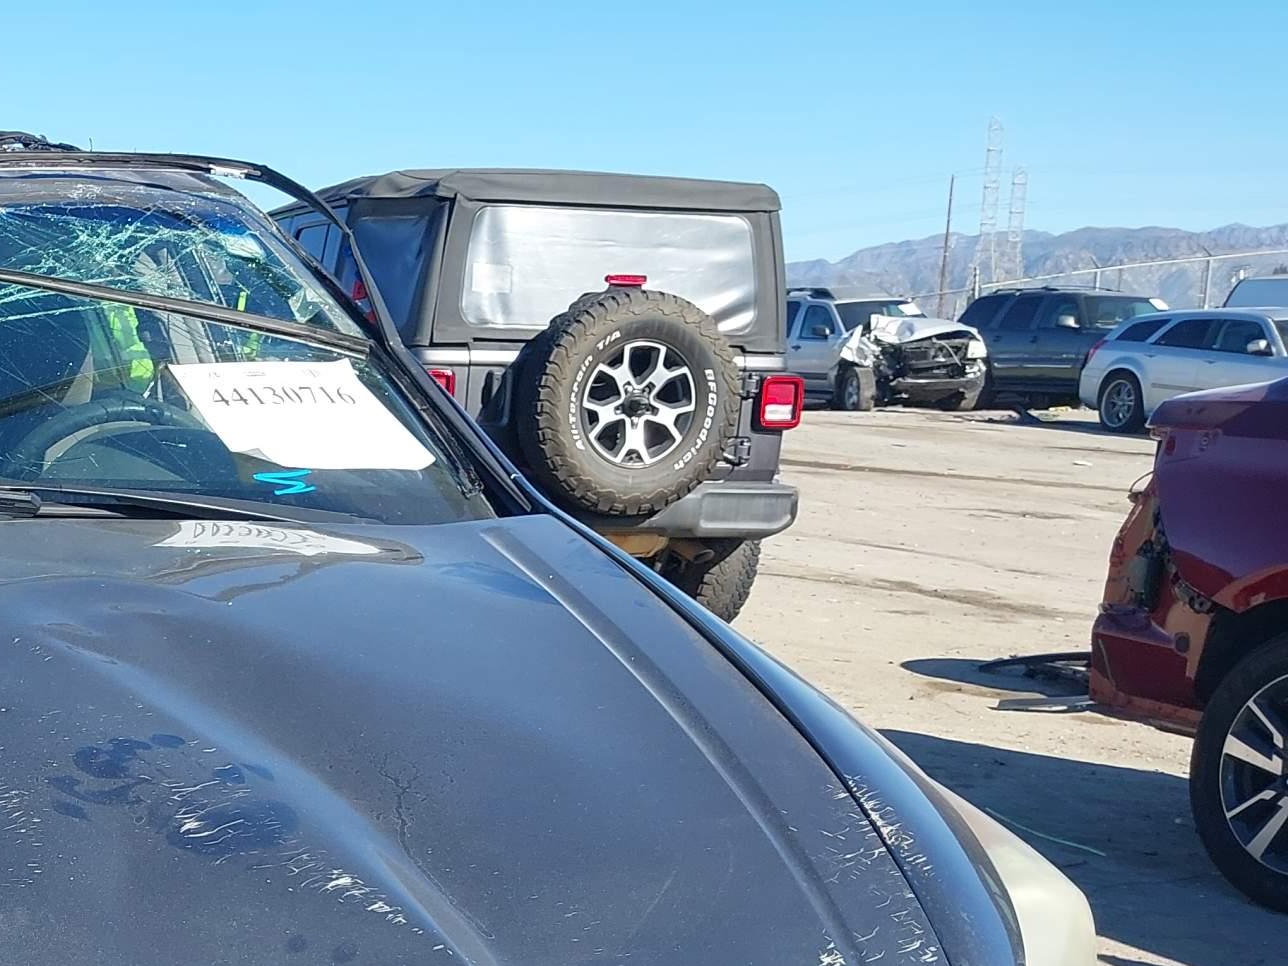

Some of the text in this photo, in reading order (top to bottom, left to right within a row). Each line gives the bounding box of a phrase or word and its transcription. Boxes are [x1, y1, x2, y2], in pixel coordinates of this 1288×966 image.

[212, 386, 356, 406] 44130716
[568, 330, 621, 450] All-Terrain T/A
[674, 368, 717, 470] BFGoodrich
